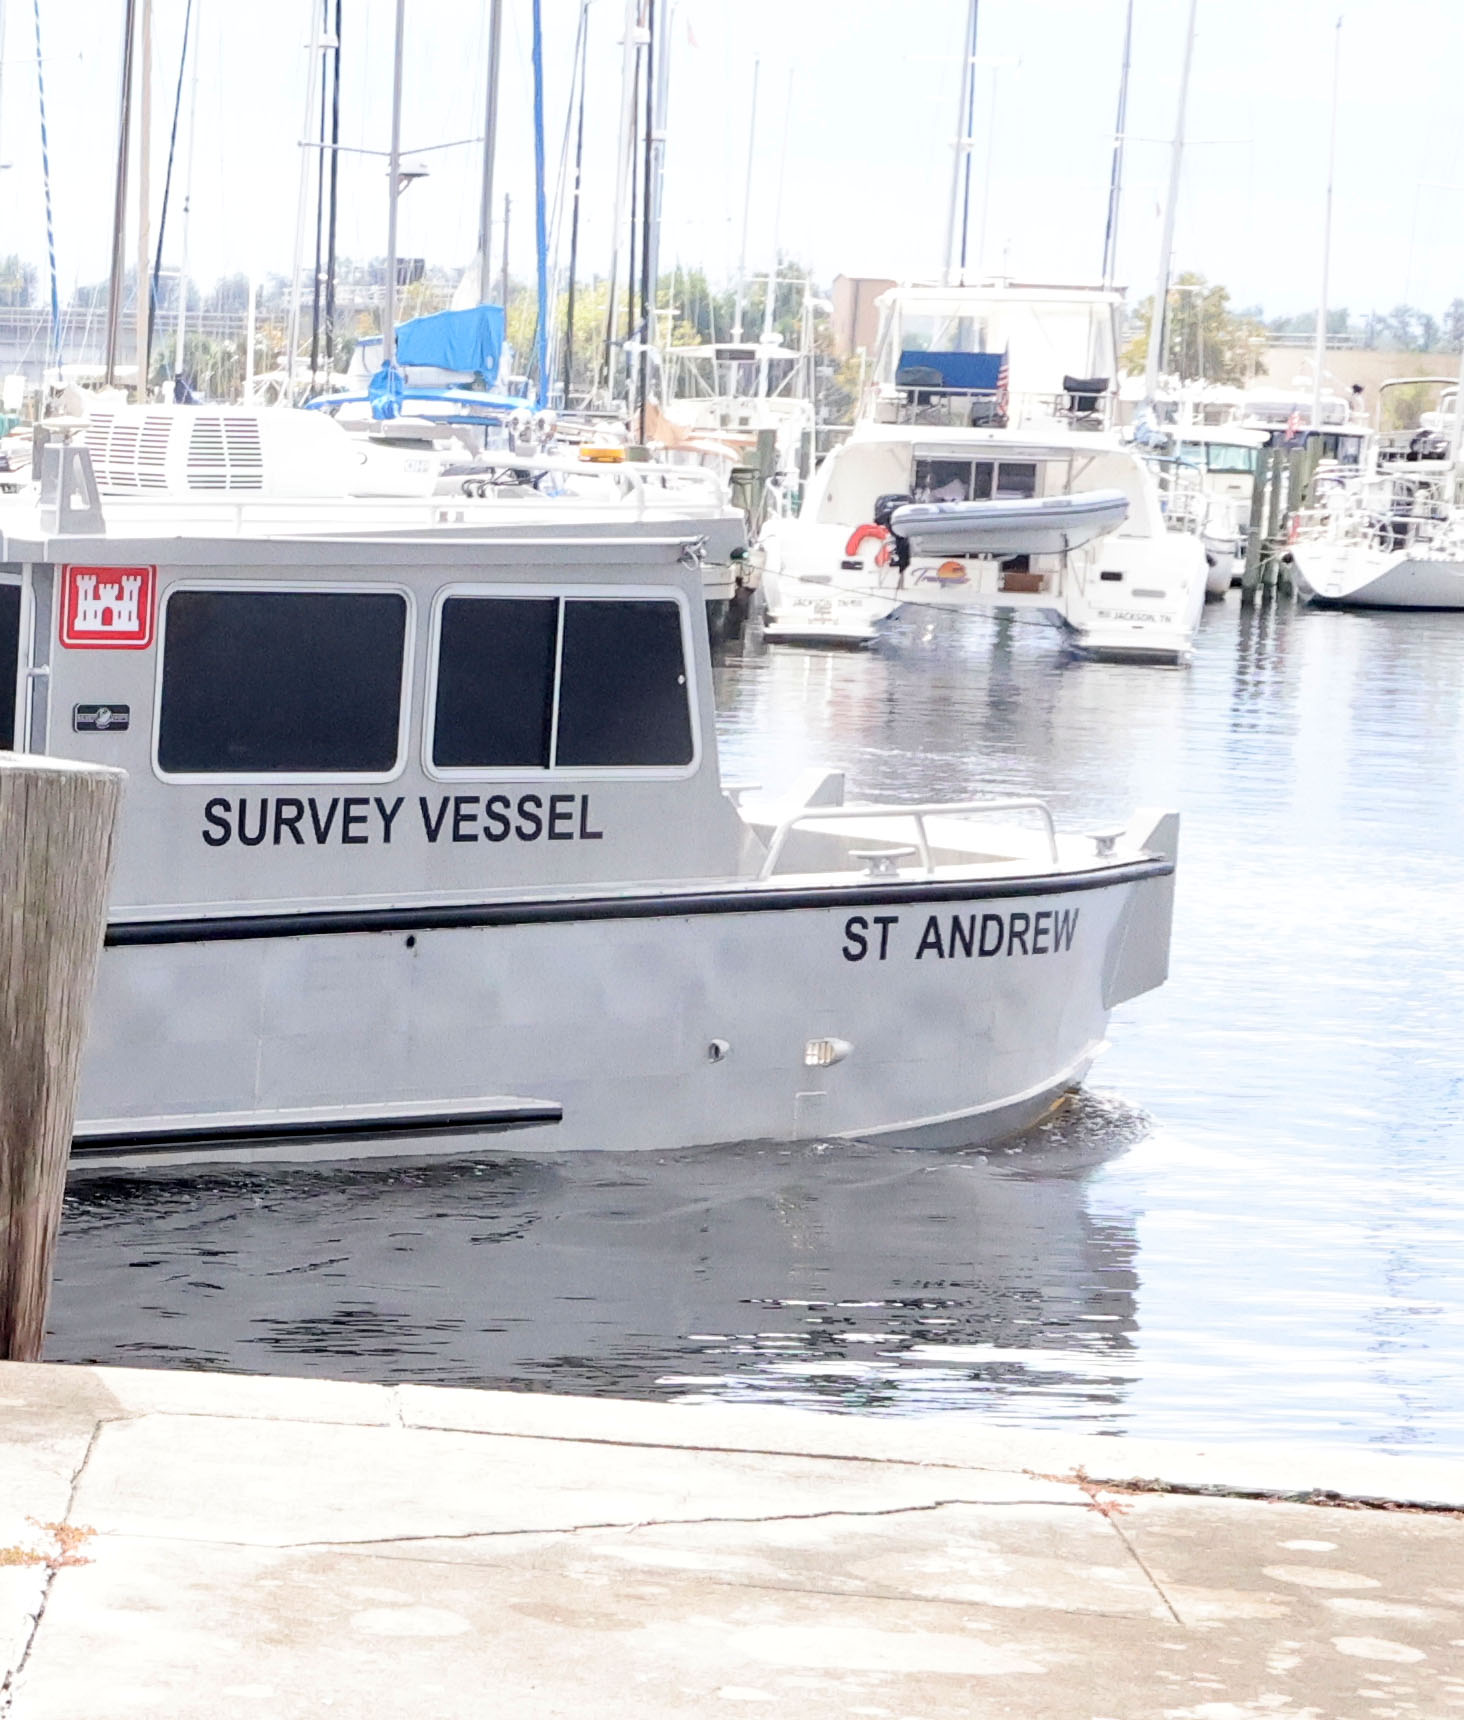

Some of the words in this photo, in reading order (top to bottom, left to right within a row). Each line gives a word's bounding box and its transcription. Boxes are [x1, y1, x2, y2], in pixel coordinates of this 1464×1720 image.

[202, 796, 405, 847] SURVEY
[419, 794, 603, 843] VESSEL
[842, 916, 899, 961] ST
[914, 908, 1079, 959] ANDREW
